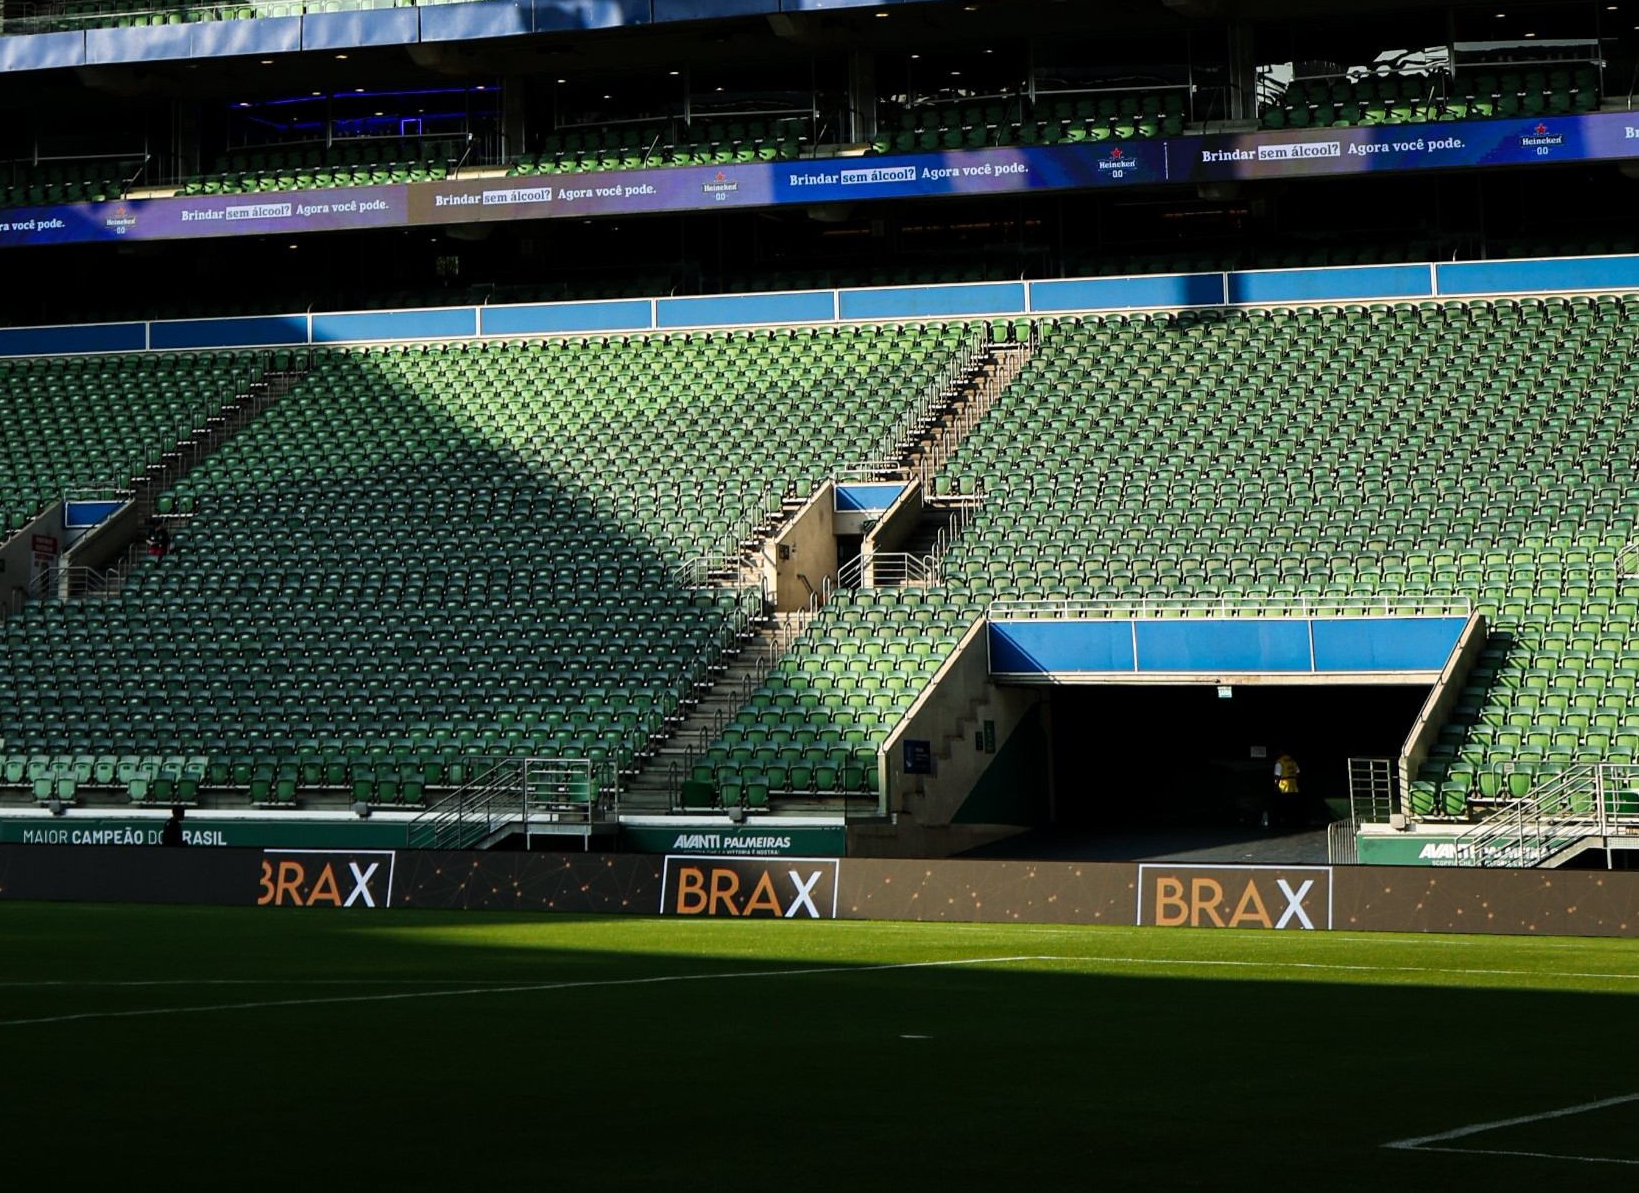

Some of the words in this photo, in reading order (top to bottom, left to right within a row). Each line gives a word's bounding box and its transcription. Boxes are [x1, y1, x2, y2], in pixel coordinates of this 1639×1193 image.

[1202, 149, 1256, 162] Brindar
[1260, 148, 1287, 159] sem
[1291, 144, 1339, 157] álcool?
[1347, 142, 1389, 155] Agora
[1392, 139, 1424, 152] você
[1427, 138, 1465, 152] pode.
[789, 174, 838, 186] Brindar
[842, 173, 868, 183] sem
[870, 169, 915, 182] álcool?
[921, 167, 959, 180] Agora
[962, 163, 991, 175] você
[994, 162, 1029, 176] pode.
[435, 195, 481, 206] Brindar
[484, 194, 507, 203] sem
[510, 190, 551, 202] álcool?
[558, 189, 593, 201] Agora
[595, 185, 622, 196] você
[624, 184, 657, 197] pode.
[182, 210, 224, 221] Brindar
[227, 210, 249, 218] sem
[251, 206, 291, 217] álcool?
[296, 205, 330, 216] Agora
[331, 201, 357, 212] você
[359, 200, 389, 212] pode.
[11, 220, 35, 231] você
[37, 219, 65, 231] pode.
[23, 830, 68, 845] MAIOR
[71, 827, 144, 845] CAMPEÃO
[673, 834, 720, 849] AVANTI
[723, 837, 791, 848] PALMEIRAS
[677, 867, 823, 918] BRAX
[1155, 877, 1314, 930] BRAX
